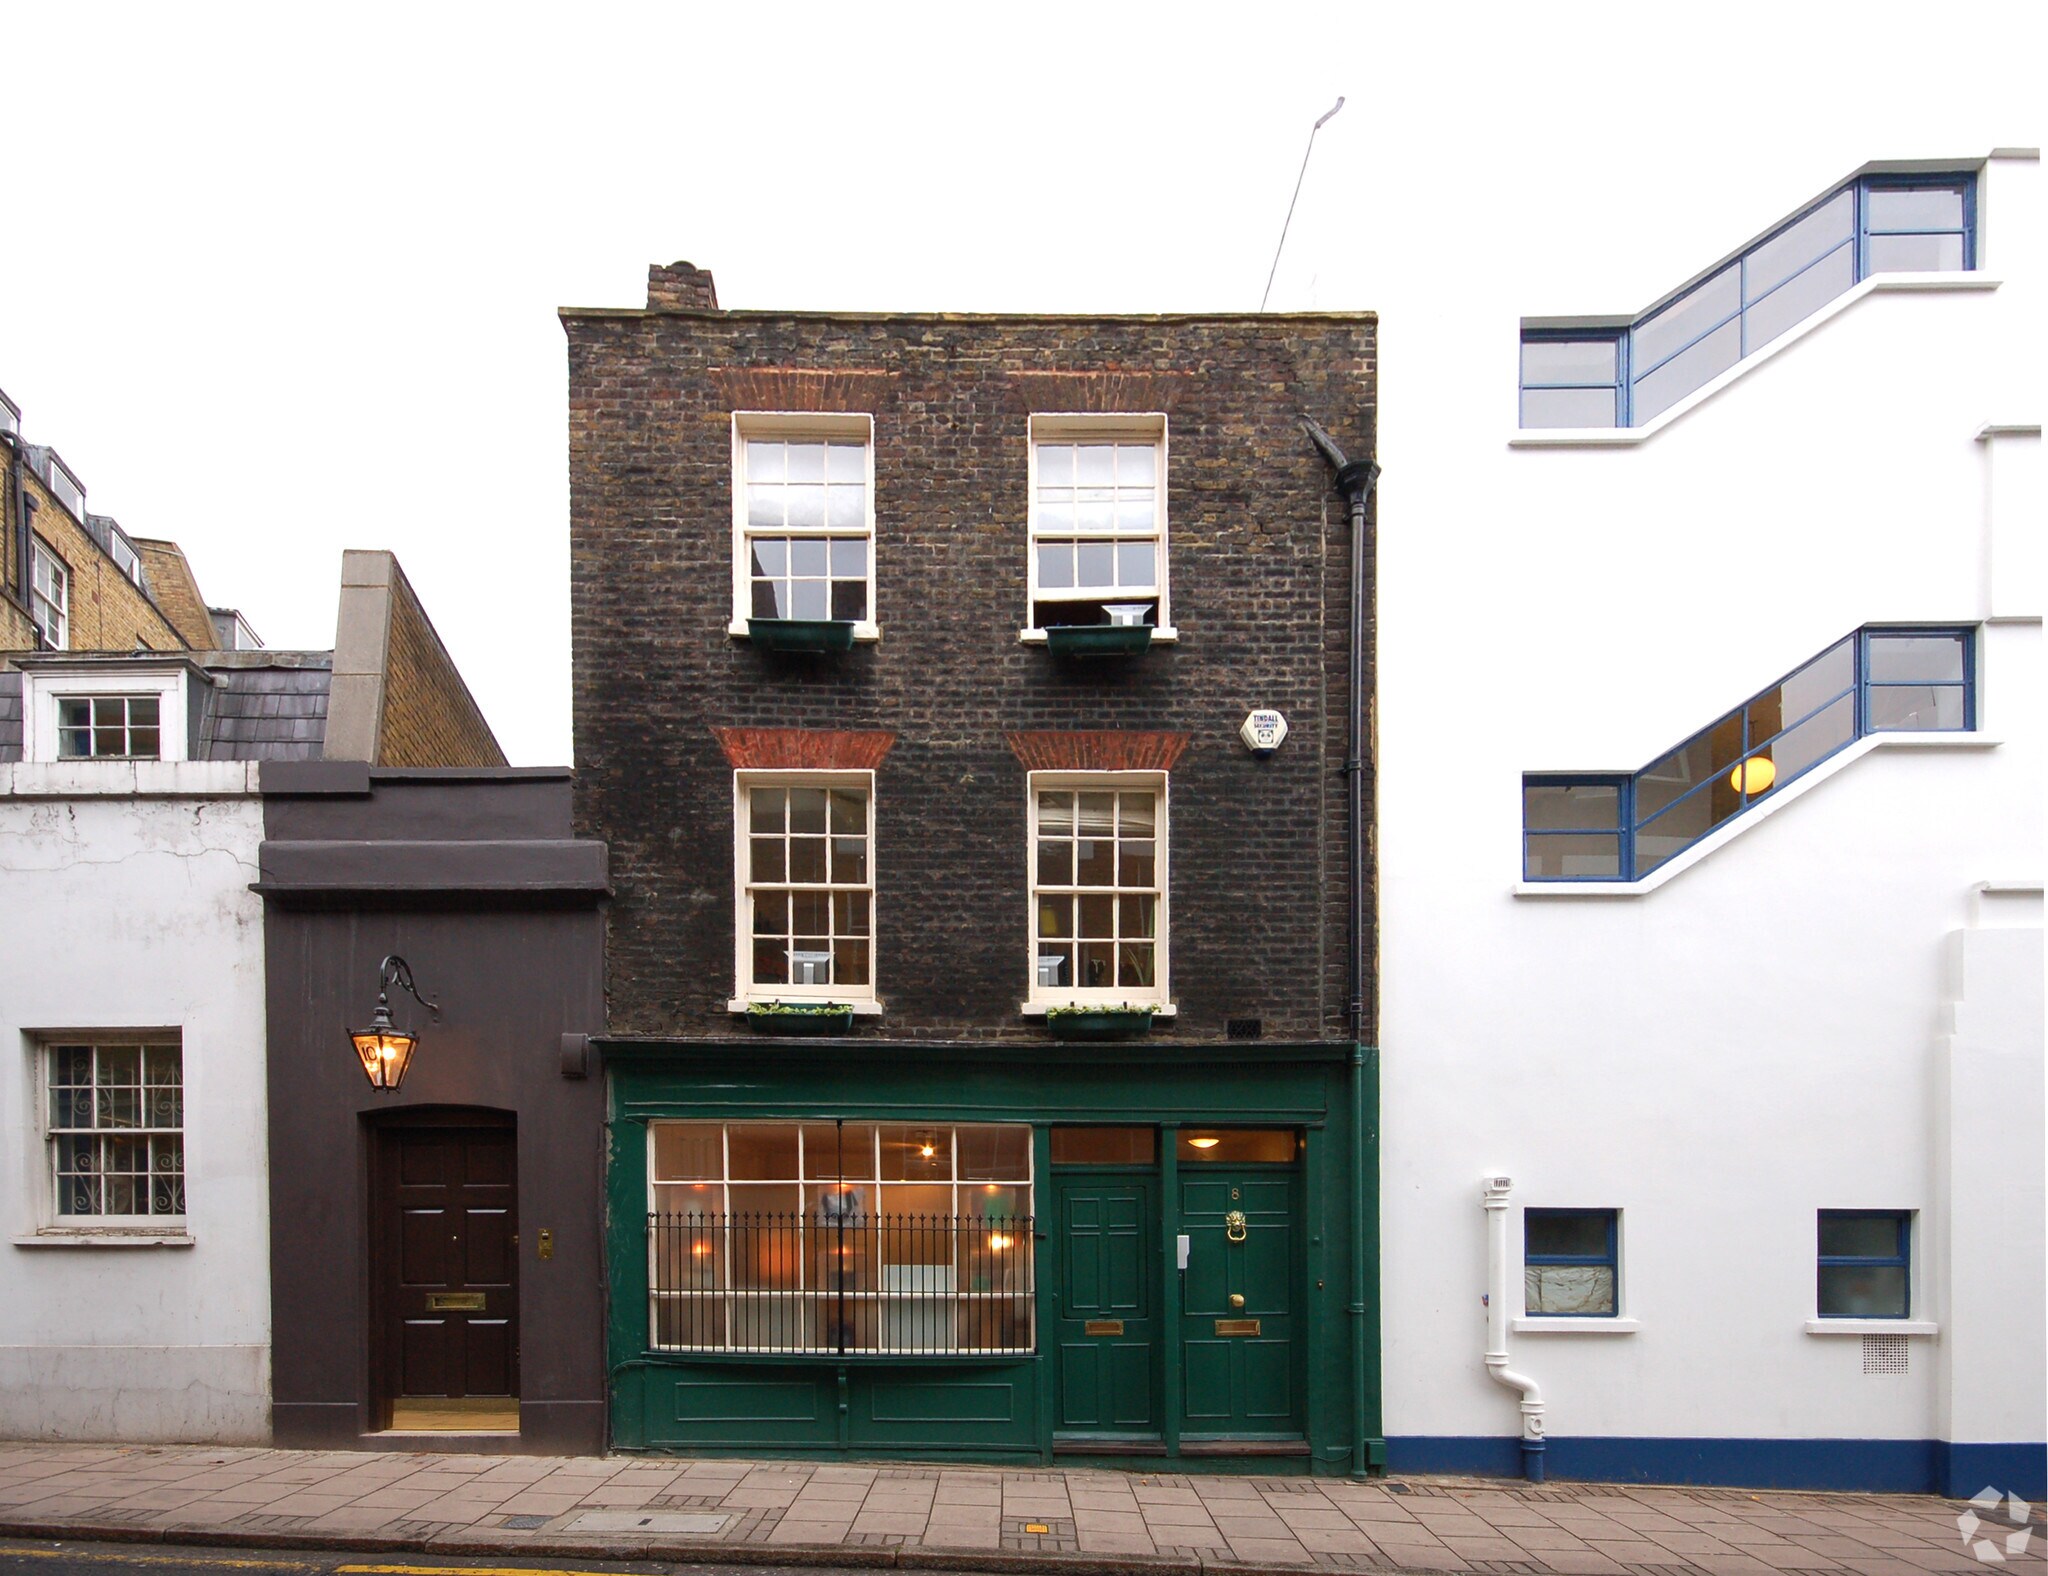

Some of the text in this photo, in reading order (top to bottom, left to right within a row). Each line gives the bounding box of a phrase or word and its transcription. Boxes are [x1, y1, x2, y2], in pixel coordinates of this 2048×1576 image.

[1253, 714, 1278, 722] TINDALL
[361, 1044, 377, 1061] 10
[1231, 1187, 1240, 1200] 8
